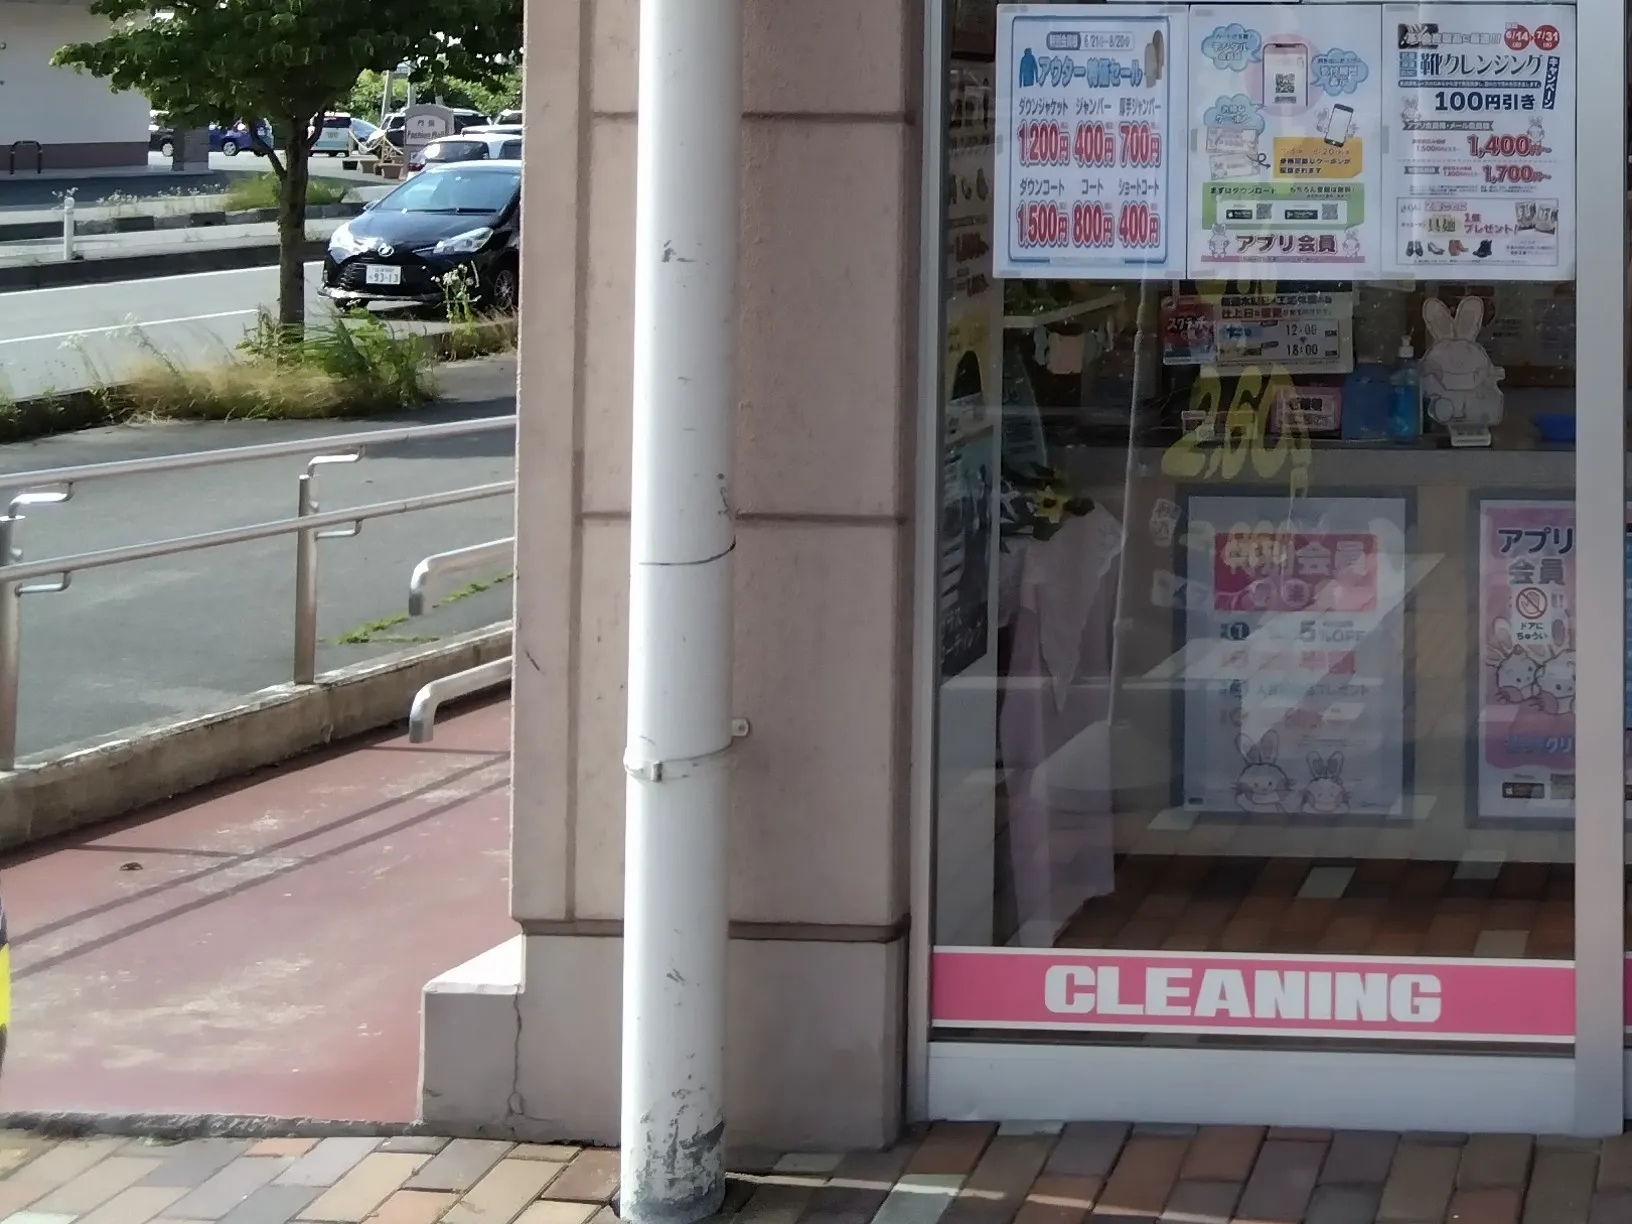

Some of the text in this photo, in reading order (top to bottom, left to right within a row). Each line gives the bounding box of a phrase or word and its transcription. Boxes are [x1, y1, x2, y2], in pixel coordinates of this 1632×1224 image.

[1420, 52, 1544, 76] 靴クレンジング
[1542, 57, 1560, 109] キャンペーン
[1434, 91, 1536, 111] 100円引き
[1073, 121, 1116, 168] 400円
[1119, 120, 1161, 168] 700円
[1118, 200, 1160, 249] 400円
[1235, 235, 1338, 255] アプリ会員
[1498, 528, 1574, 554] アプリ
[1509, 558, 1566, 586] 会員
[1044, 964, 1443, 1024] CLEANING
